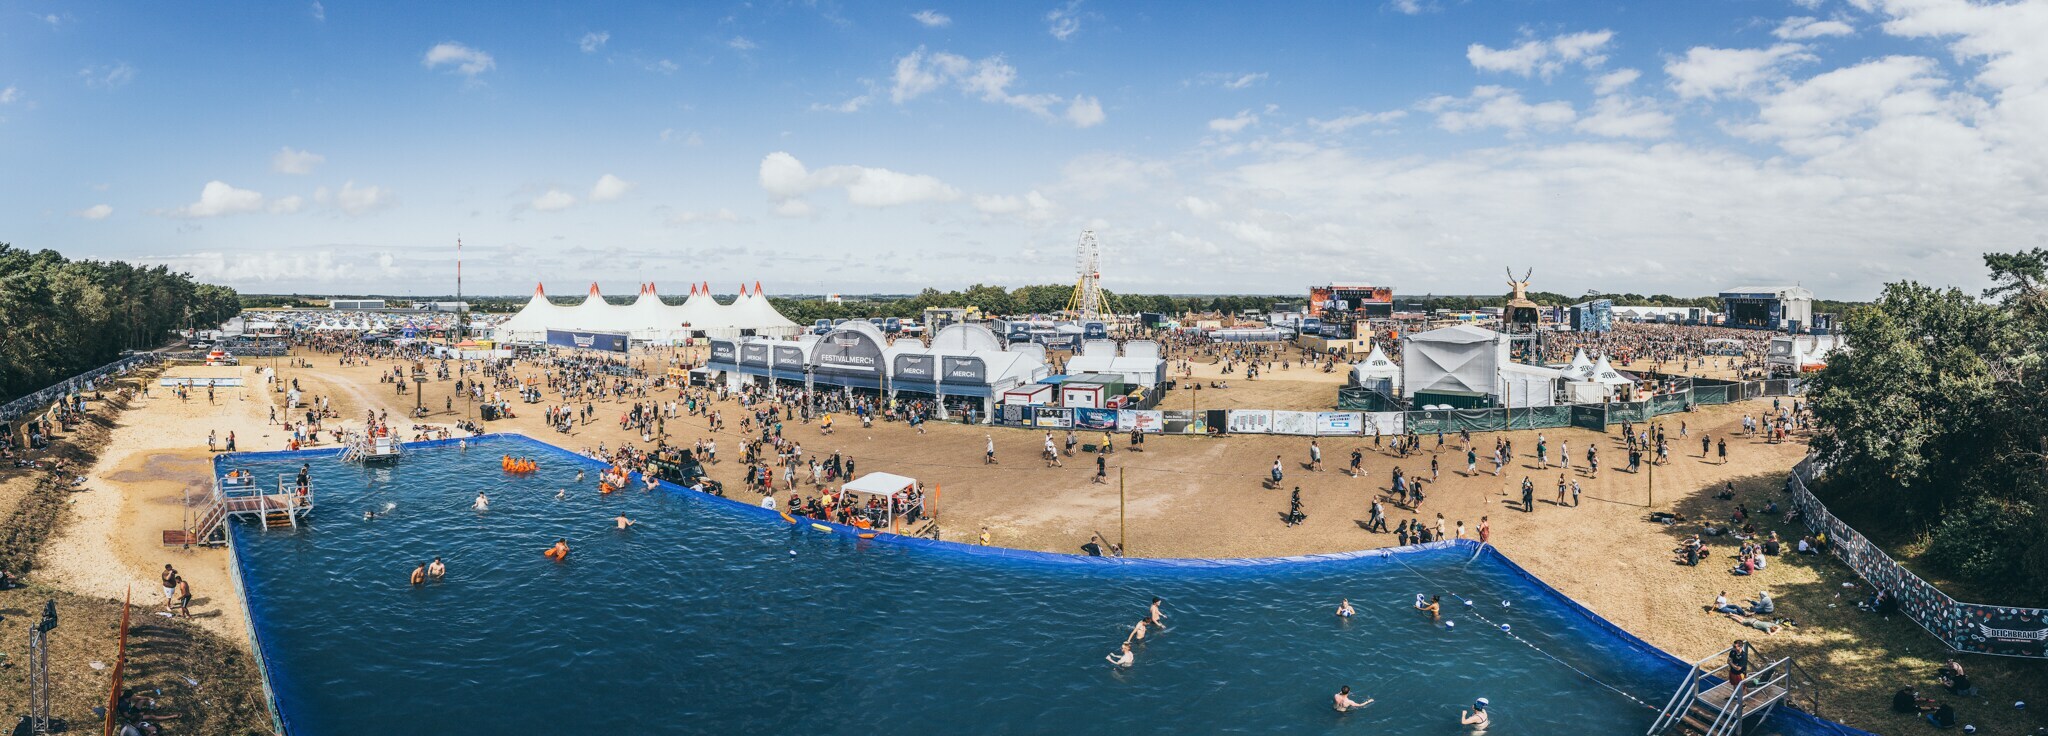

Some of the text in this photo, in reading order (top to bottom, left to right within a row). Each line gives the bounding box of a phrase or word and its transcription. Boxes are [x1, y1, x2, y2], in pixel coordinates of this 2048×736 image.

[821, 354, 875, 364] FESTIVALMERCH
[904, 367, 925, 375] MERCH
[953, 370, 976, 378] MERCH
[1601, 371, 1617, 379] JEVER
[1991, 629, 2038, 639] DEICHBRAND
